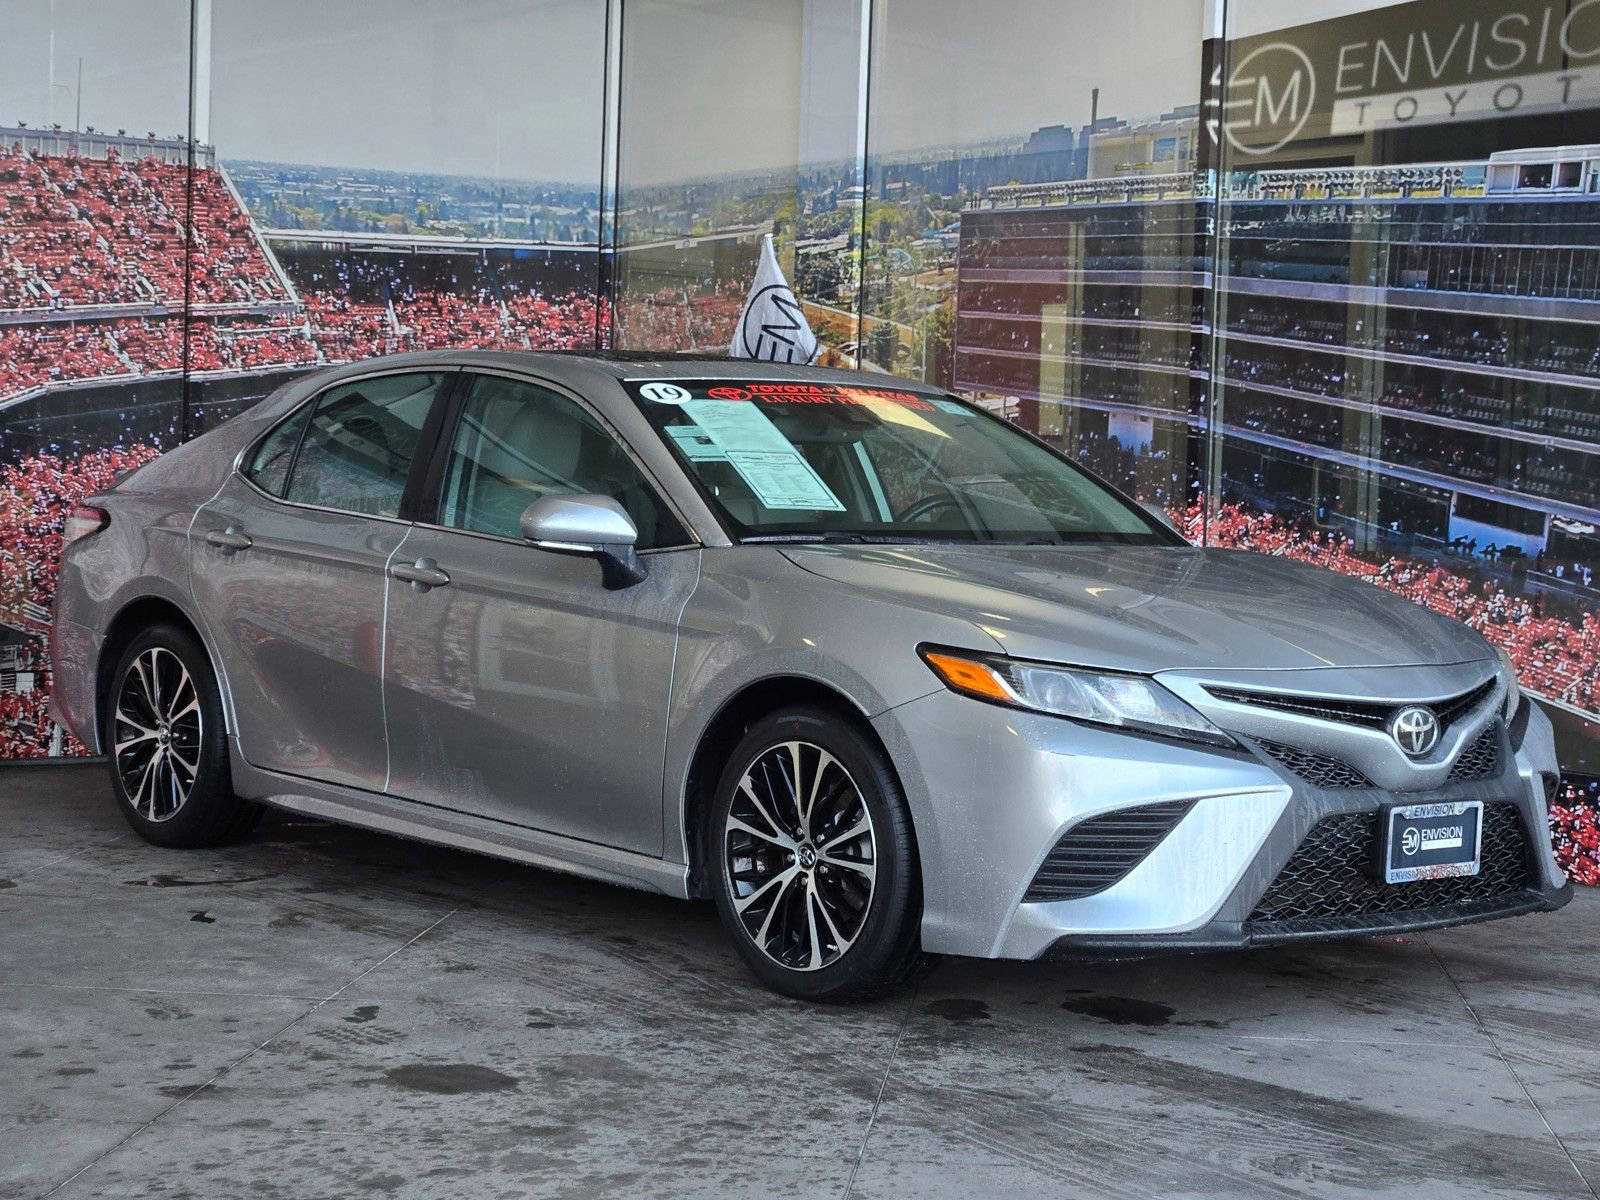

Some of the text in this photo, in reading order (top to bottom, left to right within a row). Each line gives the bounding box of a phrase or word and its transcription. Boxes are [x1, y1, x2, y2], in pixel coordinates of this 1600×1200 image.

[646, 387, 683, 400] 19
[745, 384, 823, 394] TOYOTA
[760, 395, 834, 405] LUXURY
[1414, 804, 1456, 817] ENVISION
[1421, 826, 1463, 841] ENVISION
